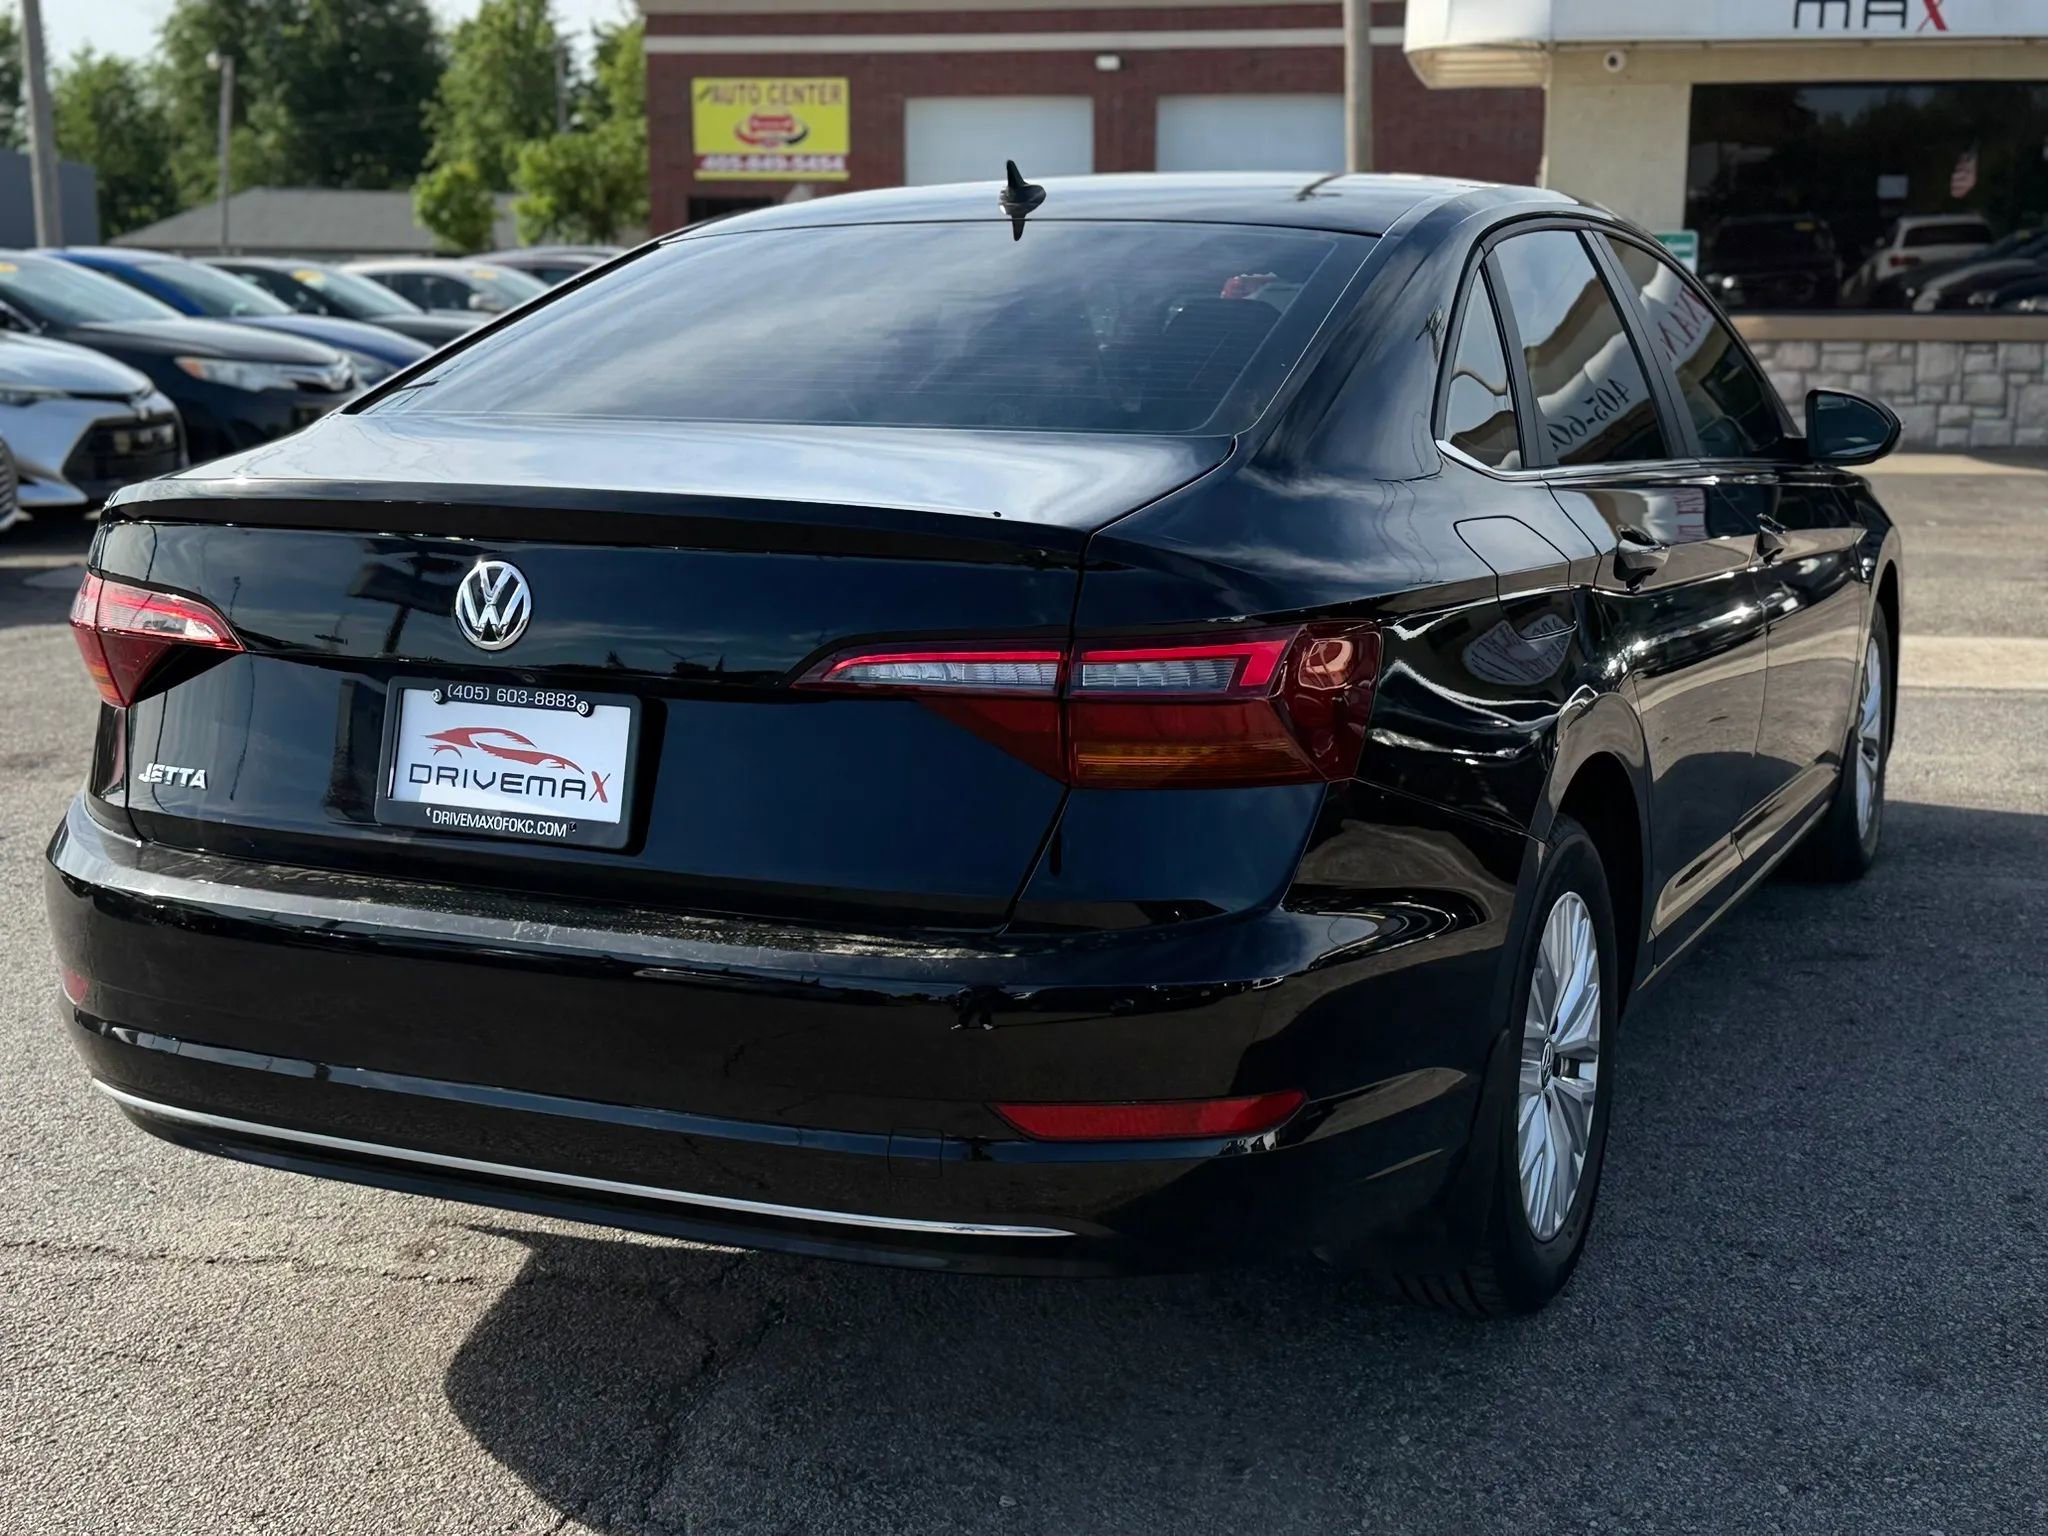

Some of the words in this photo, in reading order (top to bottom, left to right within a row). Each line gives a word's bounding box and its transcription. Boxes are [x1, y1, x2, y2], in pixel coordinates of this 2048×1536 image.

[697, 84, 761, 105] AUTO
[768, 83, 841, 105] CENTER
[447, 684, 490, 701] (405)
[497, 689, 577, 708] 603-8883
[138, 763, 207, 790] JETTA
[409, 764, 610, 803] DRIVEMAX
[432, 810, 566, 837] DRIVEMAXOFOKC.COM
